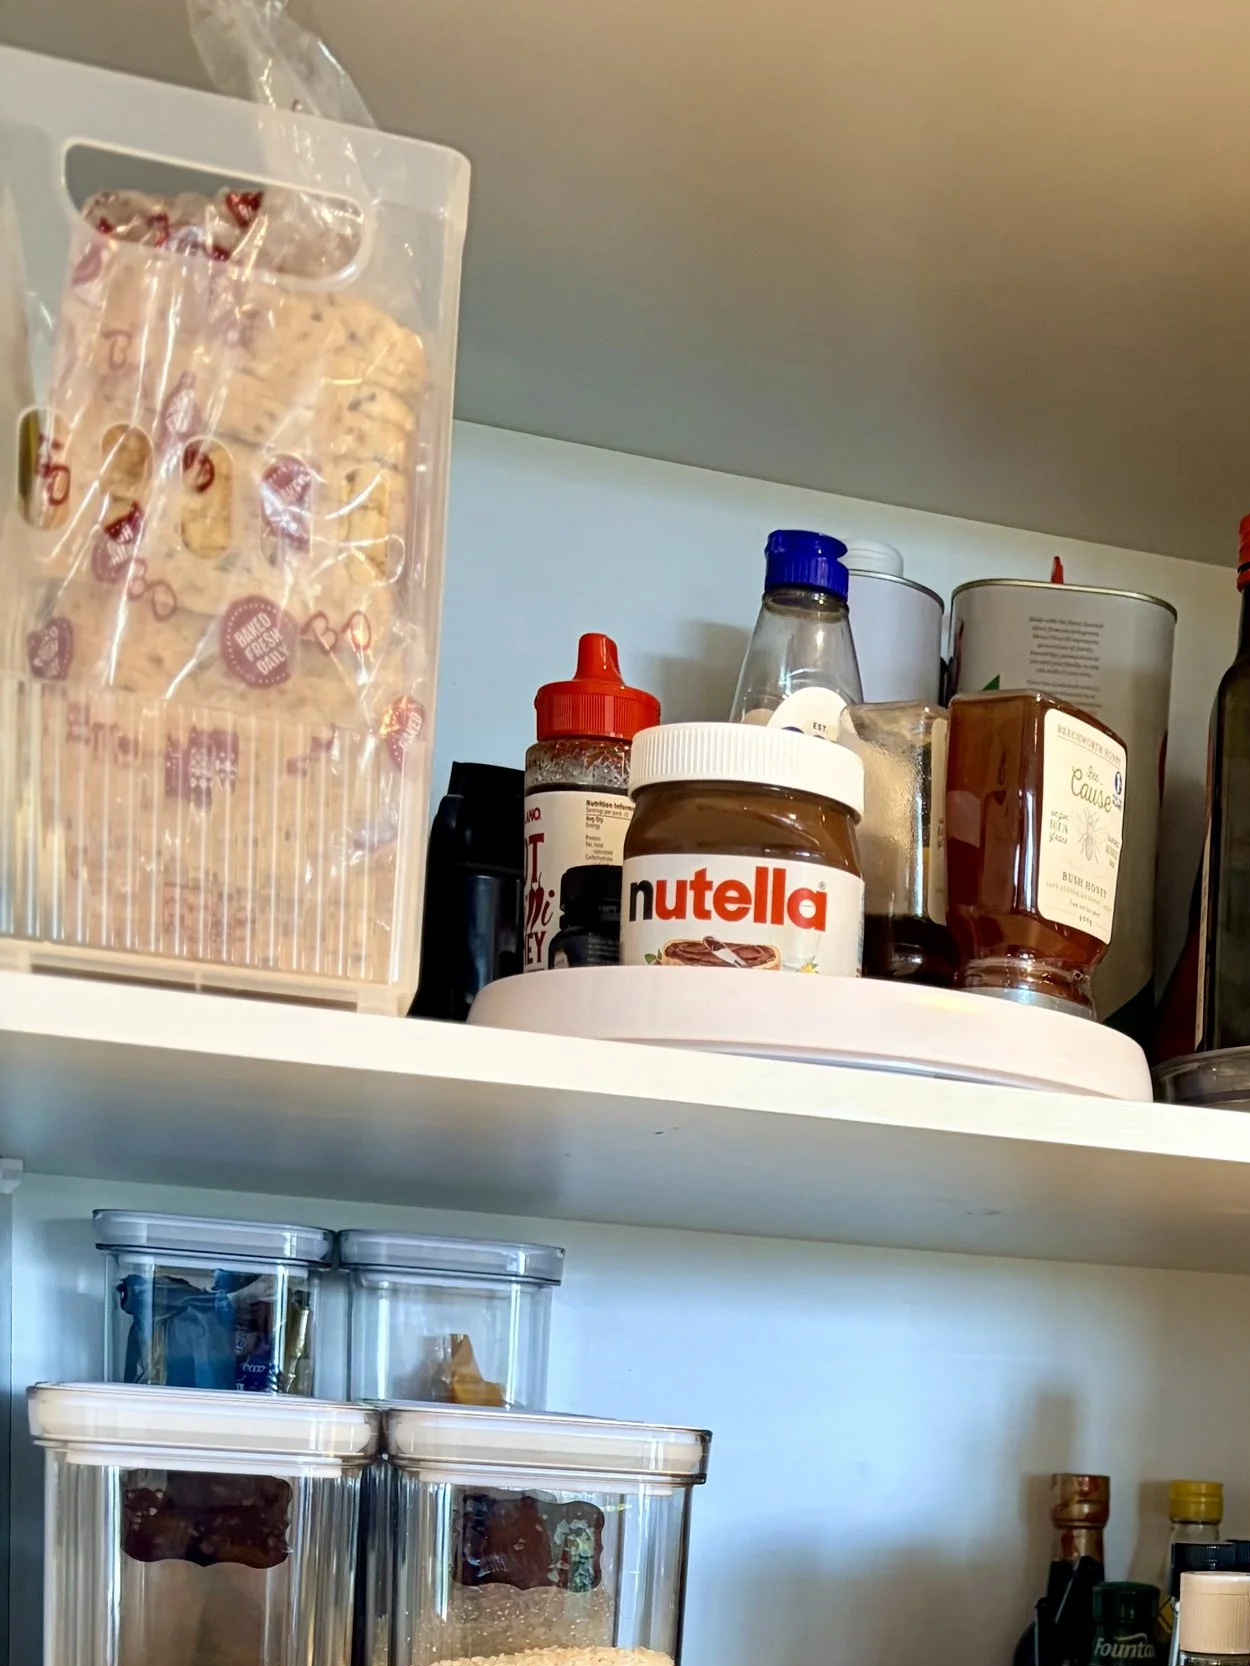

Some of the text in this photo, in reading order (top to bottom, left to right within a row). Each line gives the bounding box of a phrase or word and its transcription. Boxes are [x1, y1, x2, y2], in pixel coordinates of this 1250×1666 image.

[234, 612, 271, 648] BAKED
[245, 628, 282, 662] FRESH
[256, 644, 290, 675] DAILY
[1057, 724, 1103, 754] BEECHWORTH
[585, 800, 613, 809] Nutrition
[1071, 766, 1112, 813] Cause
[629, 866, 828, 932] nutella
[1062, 871, 1107, 899] BUSH HONEY
